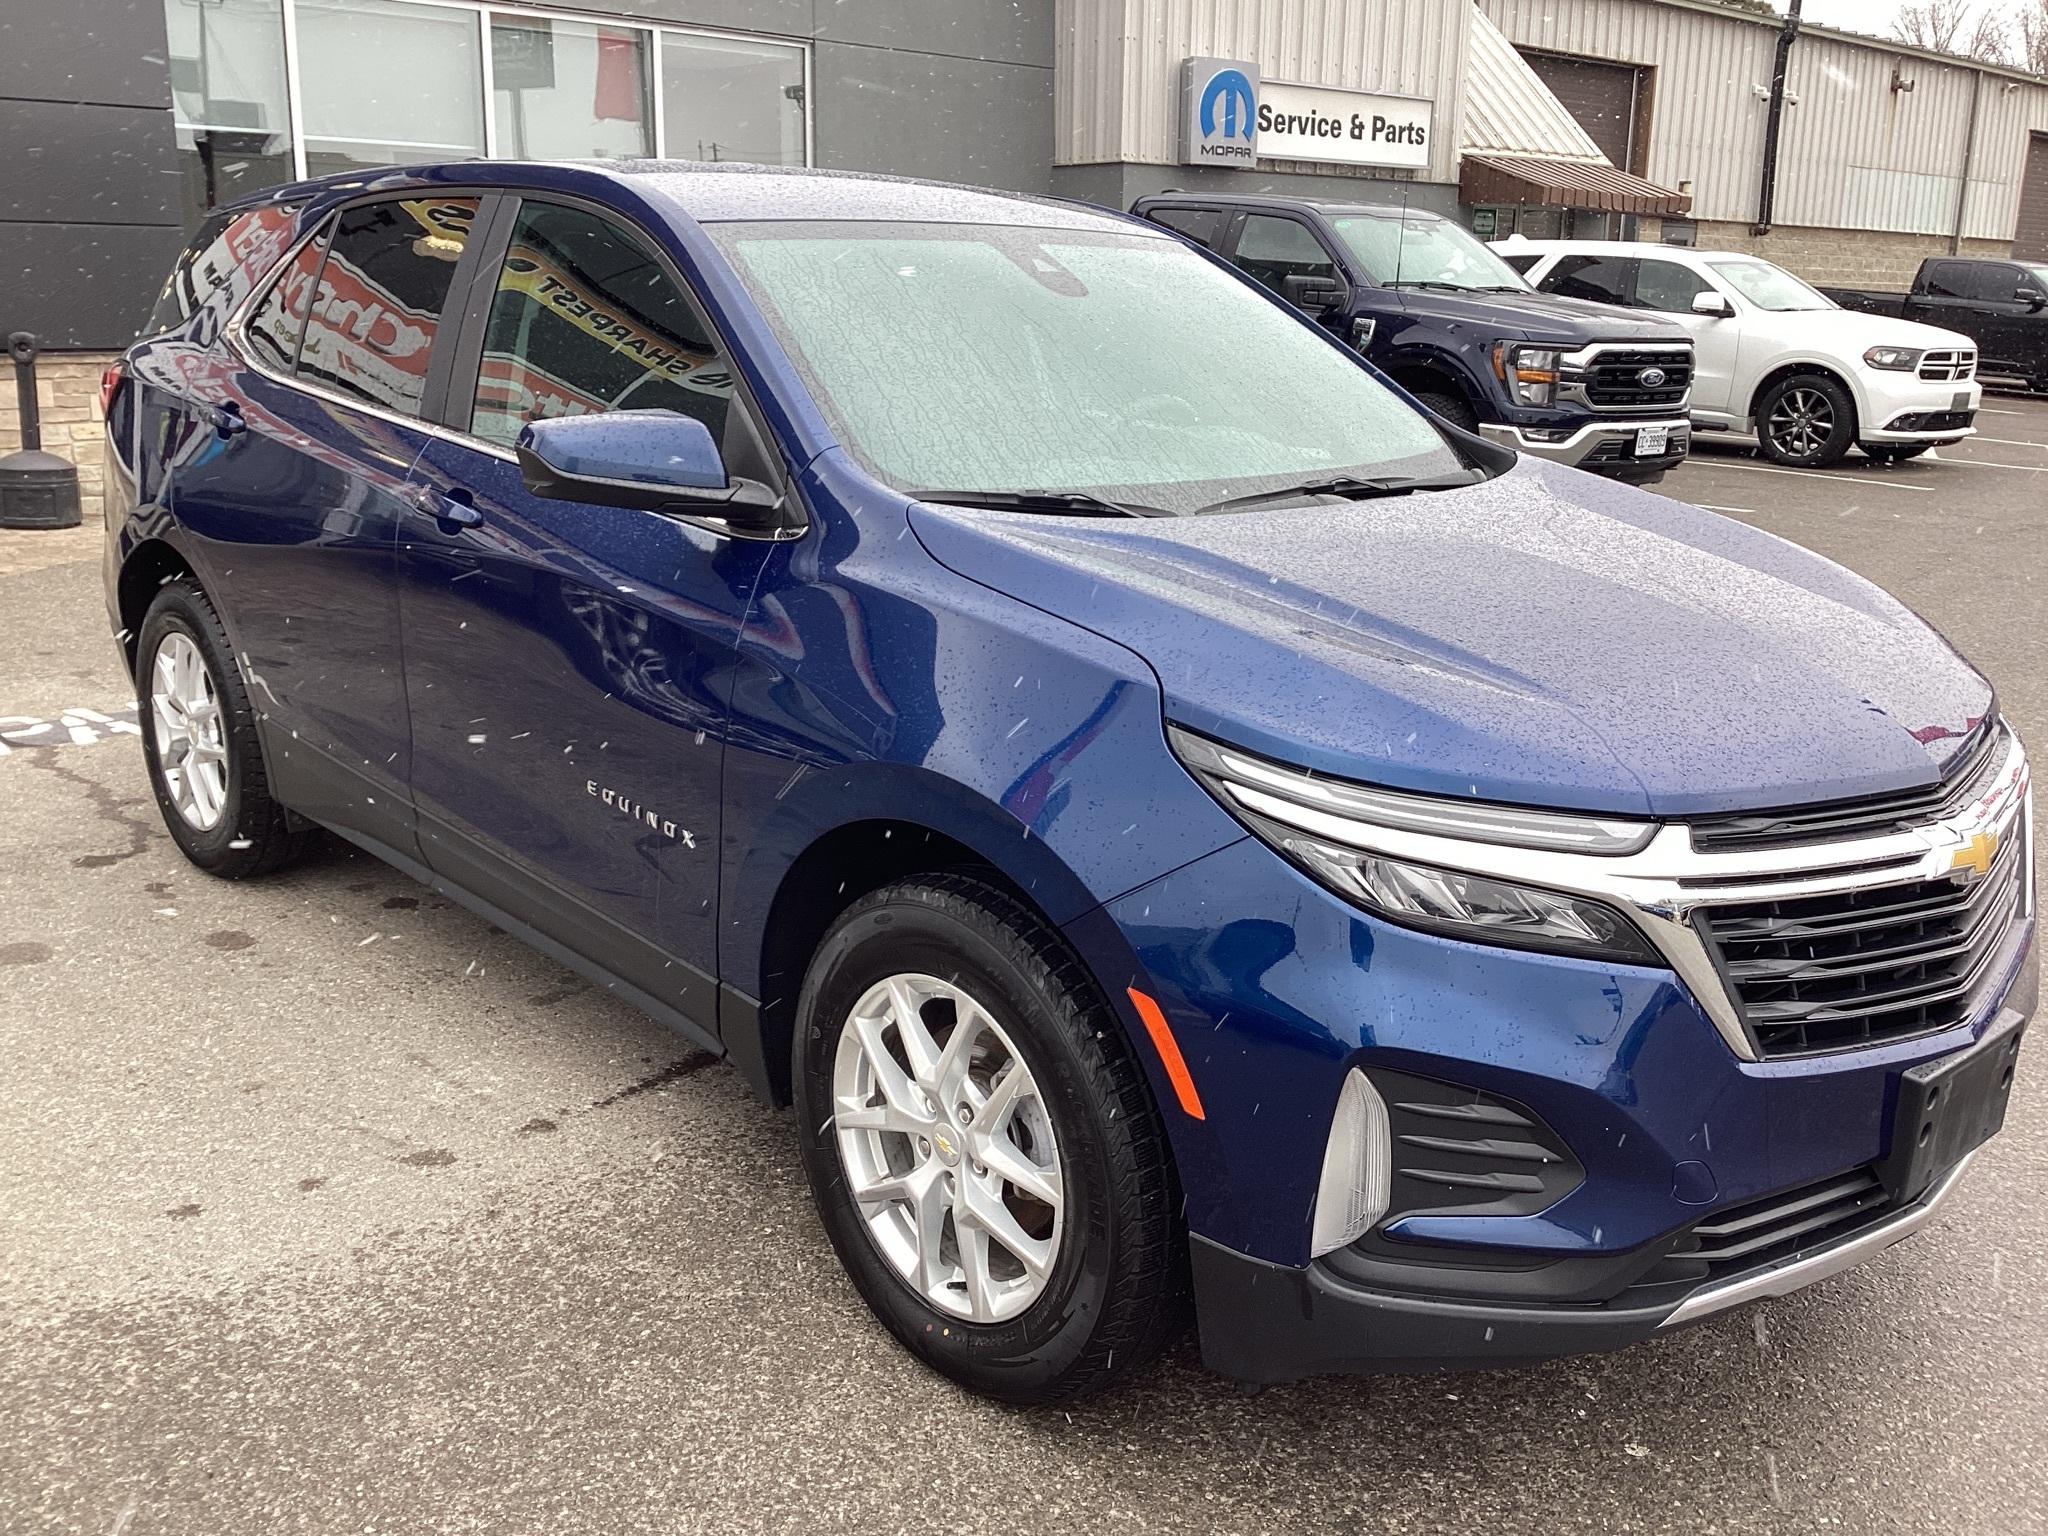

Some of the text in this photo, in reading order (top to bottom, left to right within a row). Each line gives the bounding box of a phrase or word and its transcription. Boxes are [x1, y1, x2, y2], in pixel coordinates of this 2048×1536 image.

[1257, 104, 1426, 145] Service & Parts
[1201, 144, 1252, 158] MOPAR
[586, 780, 697, 849] EQUINOX
